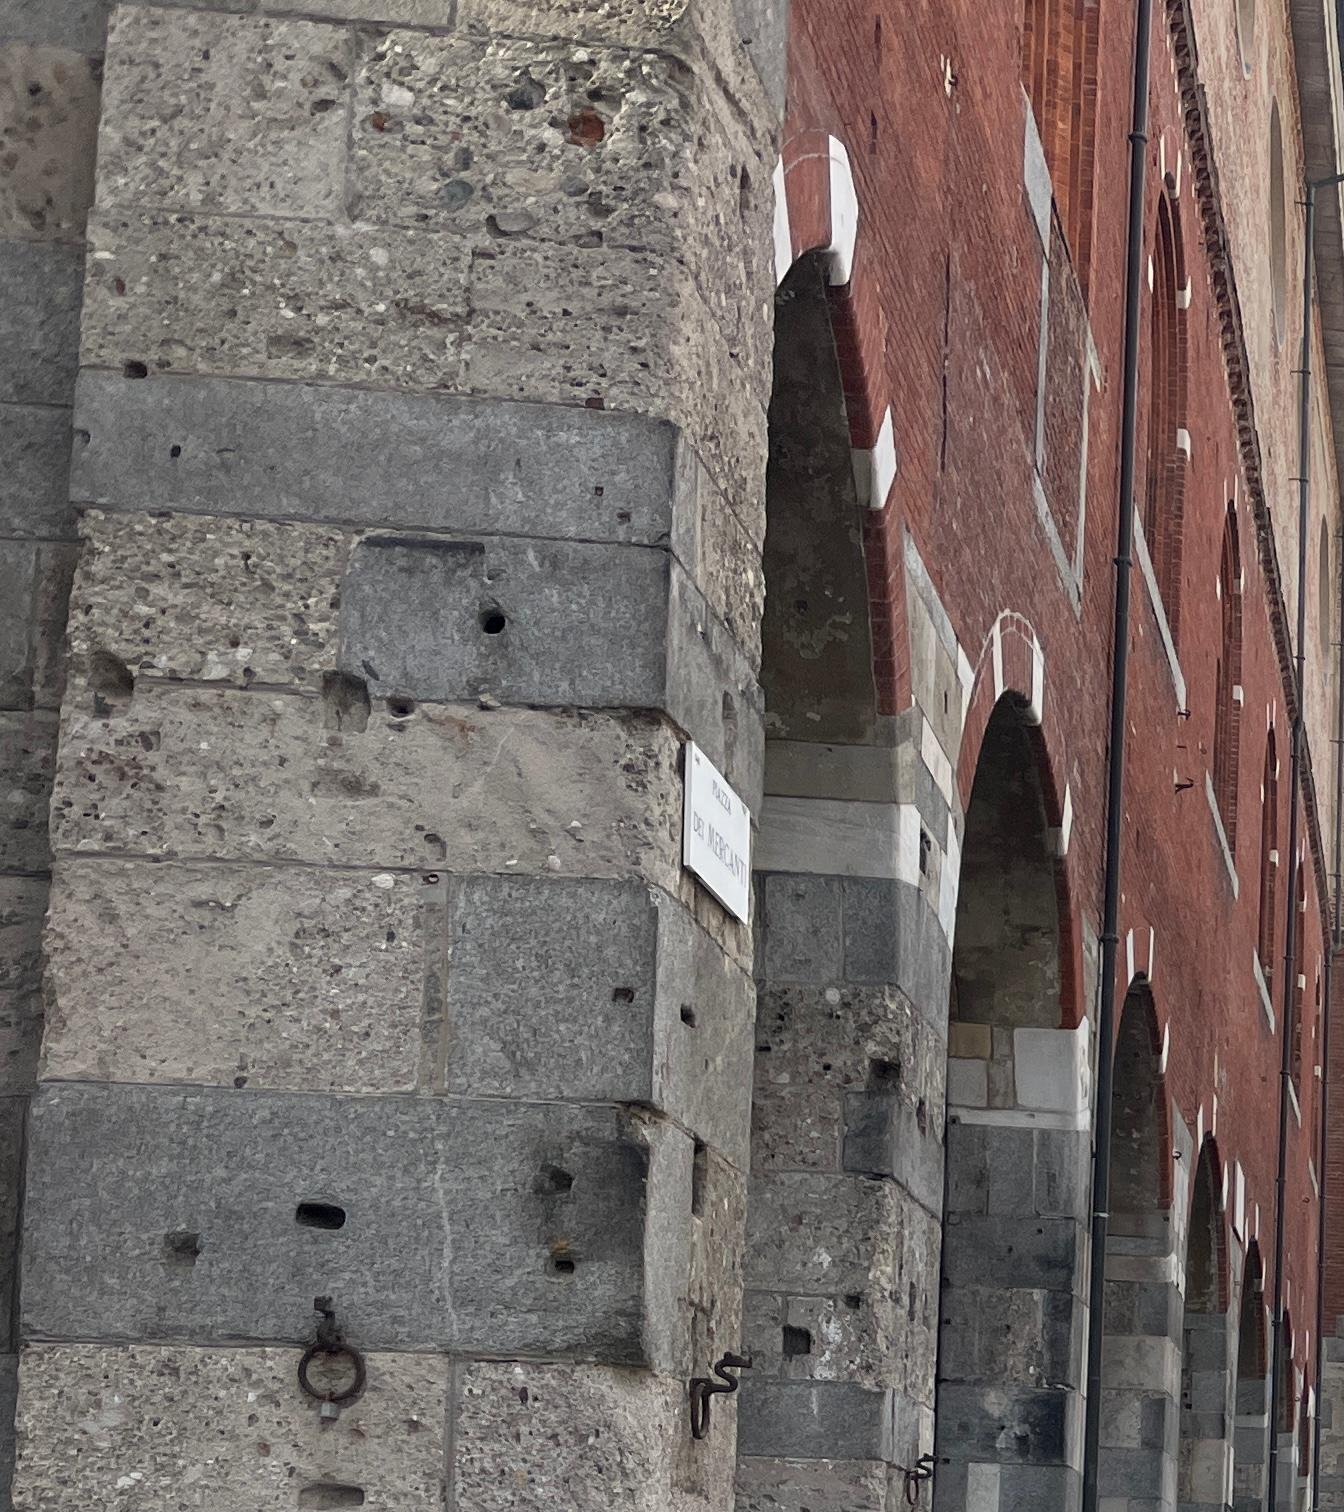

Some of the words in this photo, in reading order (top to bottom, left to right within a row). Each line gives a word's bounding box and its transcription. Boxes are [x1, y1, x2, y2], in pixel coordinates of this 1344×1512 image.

[712, 779, 732, 815] PIAZZA
[693, 810, 705, 841] DEI
[707, 823, 747, 889] MERCANTI
